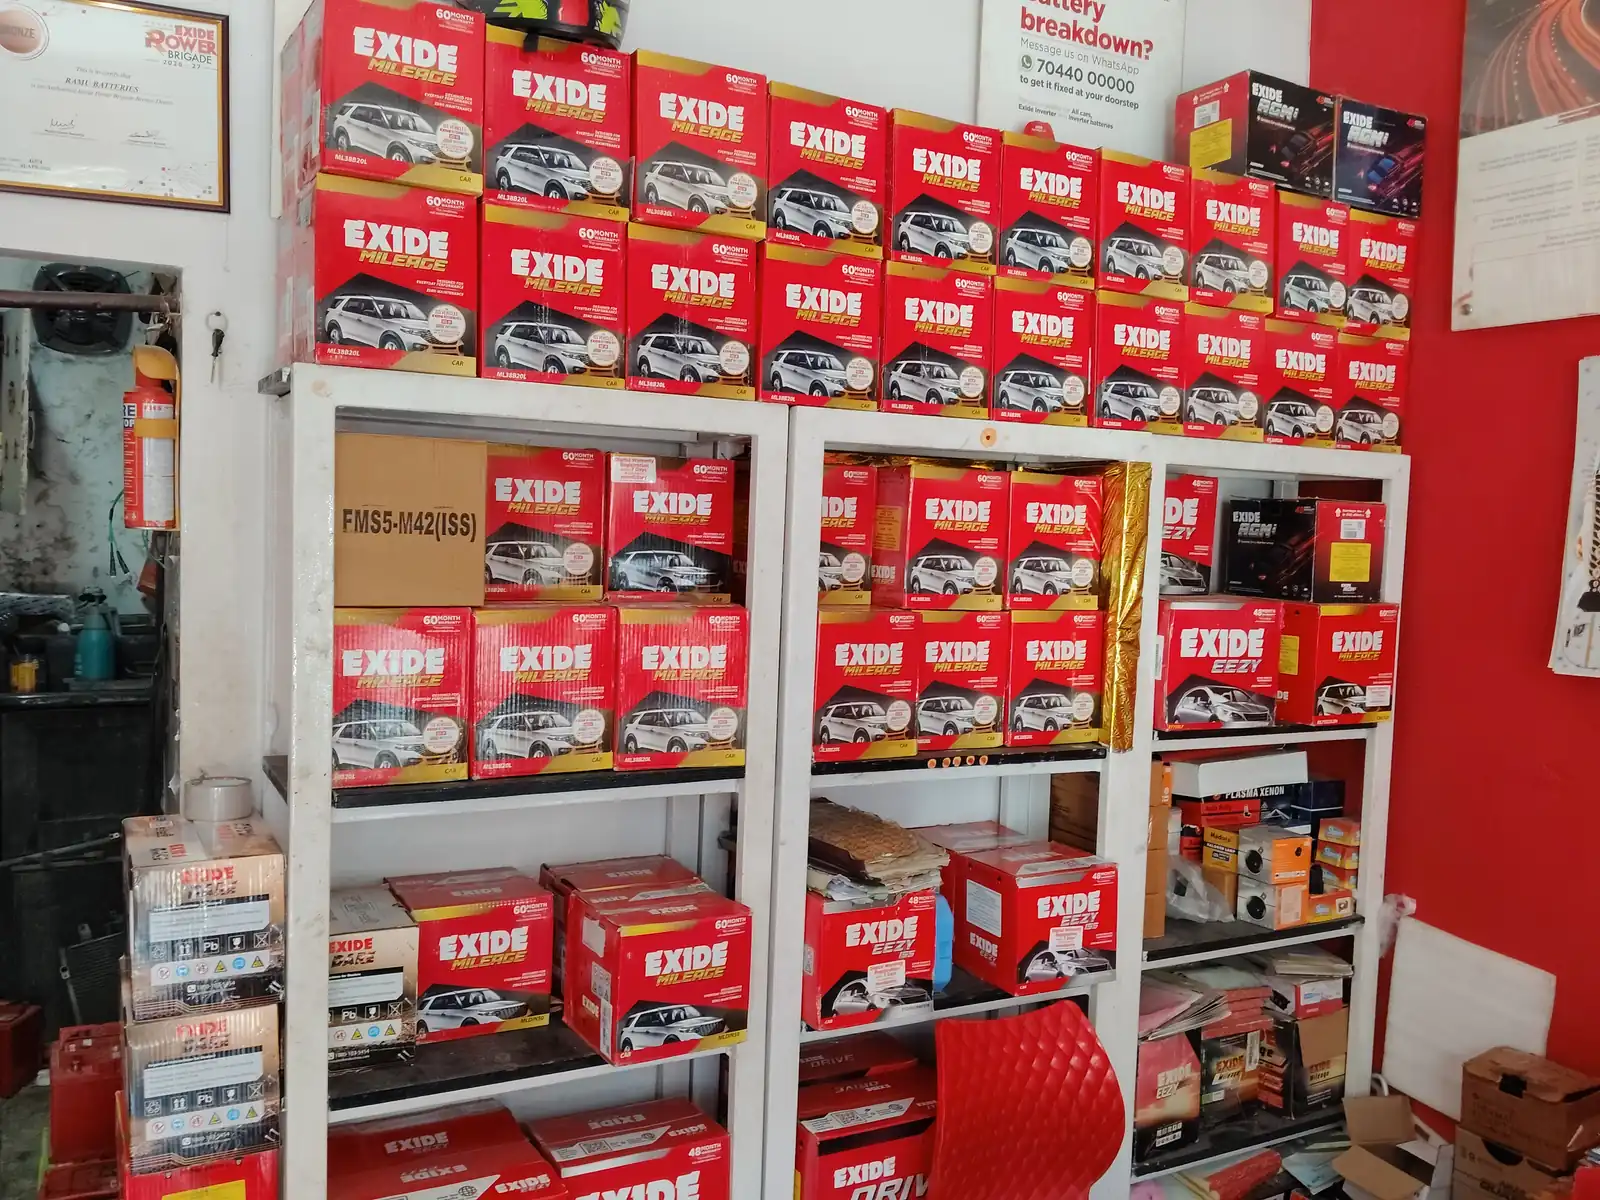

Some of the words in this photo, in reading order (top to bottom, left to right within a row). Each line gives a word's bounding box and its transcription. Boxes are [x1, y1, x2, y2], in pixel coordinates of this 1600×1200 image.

[174, 25, 214, 40] EXIDE
[1020, 6, 1154, 61] breakdown?
[168, 50, 212, 64] BRIGADE
[353, 26, 458, 74] EXIDE
[1020, 37, 1062, 56] Message
[1064, 48, 1075, 59] us
[1076, 50, 1089, 63] on
[1091, 52, 1140, 76] WhatsApp
[368, 58, 458, 87] MILEAGE
[1036, 58, 1084, 82] 70440
[1087, 71, 1135, 95] 00000
[93, 80, 140, 93] BATTERIES
[512, 69, 607, 111] EXIDE
[1019, 74, 1028, 84] to
[1030, 77, 1044, 90] get
[1045, 79, 1052, 90] it
[1053, 81, 1073, 95] fixed
[1075, 87, 1084, 97] at
[1085, 90, 1103, 104] your
[1104, 92, 1139, 110] doorstep
[1252, 82, 1282, 102] EXIDE
[526, 98, 607, 124] MILEAGE
[659, 92, 745, 132] EXIDE
[1018, 103, 1035, 113] Exide
[1035, 106, 1057, 117] Inverter
[1079, 109, 1093, 119] cars,
[1343, 111, 1373, 129] EXIDE
[671, 119, 745, 144] MILEAGE
[1068, 113, 1089, 124] Inverter
[1090, 117, 1114, 131] batteries
[789, 121, 867, 159] EXIDE
[799, 148, 865, 170] MILEAGE
[913, 148, 981, 183] EXIDE
[459, 175, 472, 183] CAR
[922, 173, 981, 193] MILEAGE
[1020, 167, 1083, 200] EXIDE
[1028, 191, 1082, 209] MILEAGE
[1117, 182, 1176, 213] EXIDE
[607, 208, 620, 216] CAR
[1125, 203, 1175, 223] MILEAGE
[1206, 199, 1261, 228] EXIDE
[343, 218, 449, 259] EXIDE
[1213, 220, 1261, 237] MILEAGE
[1292, 222, 1340, 250] EXIDE
[358, 250, 449, 272] MILEAGE
[1298, 243, 1339, 258] MILEAGE
[1360, 238, 1408, 264] EXIDE
[511, 248, 605, 285] EXIDE
[1365, 257, 1404, 273] MILEAGE
[524, 277, 605, 297] MILEAGE
[651, 264, 736, 298] EXIDE
[663, 290, 736, 310] MILEAGE
[785, 284, 863, 316] EXIDE
[796, 309, 862, 327] MILEAGE
[905, 298, 974, 328] EXIDE
[914, 321, 973, 339] MILEAGE
[1011, 310, 1074, 339] EXIDE
[1020, 333, 1074, 349] MILEAGE
[1114, 324, 1171, 352] EXIDE
[1198, 333, 1252, 360] EXIDE
[451, 359, 464, 367] CAR
[1121, 345, 1169, 361] MILEAGE
[1205, 354, 1251, 370] MILEAGE
[1275, 349, 1326, 374] EXIDE
[1282, 368, 1325, 383] MILEAGE
[1349, 361, 1397, 384] EXIDE
[1355, 379, 1395, 392] MILEAGE
[495, 476, 583, 505] EXIDE
[506, 500, 581, 517] MILEAGE
[632, 490, 713, 516] EXIDE
[821, 496, 857, 518] IDE
[925, 497, 992, 522] EXIDE
[1026, 502, 1089, 525] EXIDE
[341, 507, 478, 543] FMS5-M42(ISS)
[821, 518, 856, 528] EAGE
[933, 520, 990, 533] MILEAGE
[1232, 511, 1260, 522] EXIDE
[1034, 523, 1086, 535] MILEAGE
[1162, 526, 1196, 540] EZY
[580, 587, 593, 595] CAR
[925, 639, 991, 663] EXIDE
[1026, 639, 1087, 661] EXIDE
[1180, 628, 1265, 658] EXIDE
[1331, 630, 1384, 653] EXIDE
[341, 647, 446, 677] EXIDE
[499, 644, 593, 673] EXIDE
[641, 643, 728, 671] EXIDE
[835, 641, 905, 666] EXIDE
[514, 668, 591, 684] MILEAGE
[653, 668, 726, 682] MILEAGE
[843, 664, 902, 677] MILEAGE
[933, 661, 990, 673] MILEAGE
[1034, 660, 1086, 672] MILEAGE
[1211, 659, 1262, 674] EEZY
[356, 674, 445, 689] MILEAGE
[1225, 788, 1259, 799] PLASMA
[1260, 786, 1284, 796] XENON
[1037, 889, 1101, 919] EXIDE
[1060, 911, 1099, 927] EEZY
[845, 915, 919, 947] EXIDE
[204, 941, 219, 952] Pb
[329, 937, 373, 953] EXIDE
[439, 926, 529, 961] EXIDE
[872, 938, 916, 955] EEZY
[970, 932, 999, 957] EXIDE
[451, 950, 528, 971] MILEAGE
[645, 941, 728, 977] EXIDE
[656, 965, 727, 987] MILEAGE
[342, 1011, 356, 1020] Pb
[1216, 1055, 1244, 1072] EXIDE
[1310, 1060, 1331, 1073] EXIDE
[198, 1095, 213, 1105] Pb
[667, 1123, 707, 1138] EXIDE
[385, 1131, 449, 1155] EXIDE
[833, 1156, 896, 1189] EXIDE
[495, 1173, 550, 1194] EXIDE
[849, 1173, 930, 1200] DRIV
